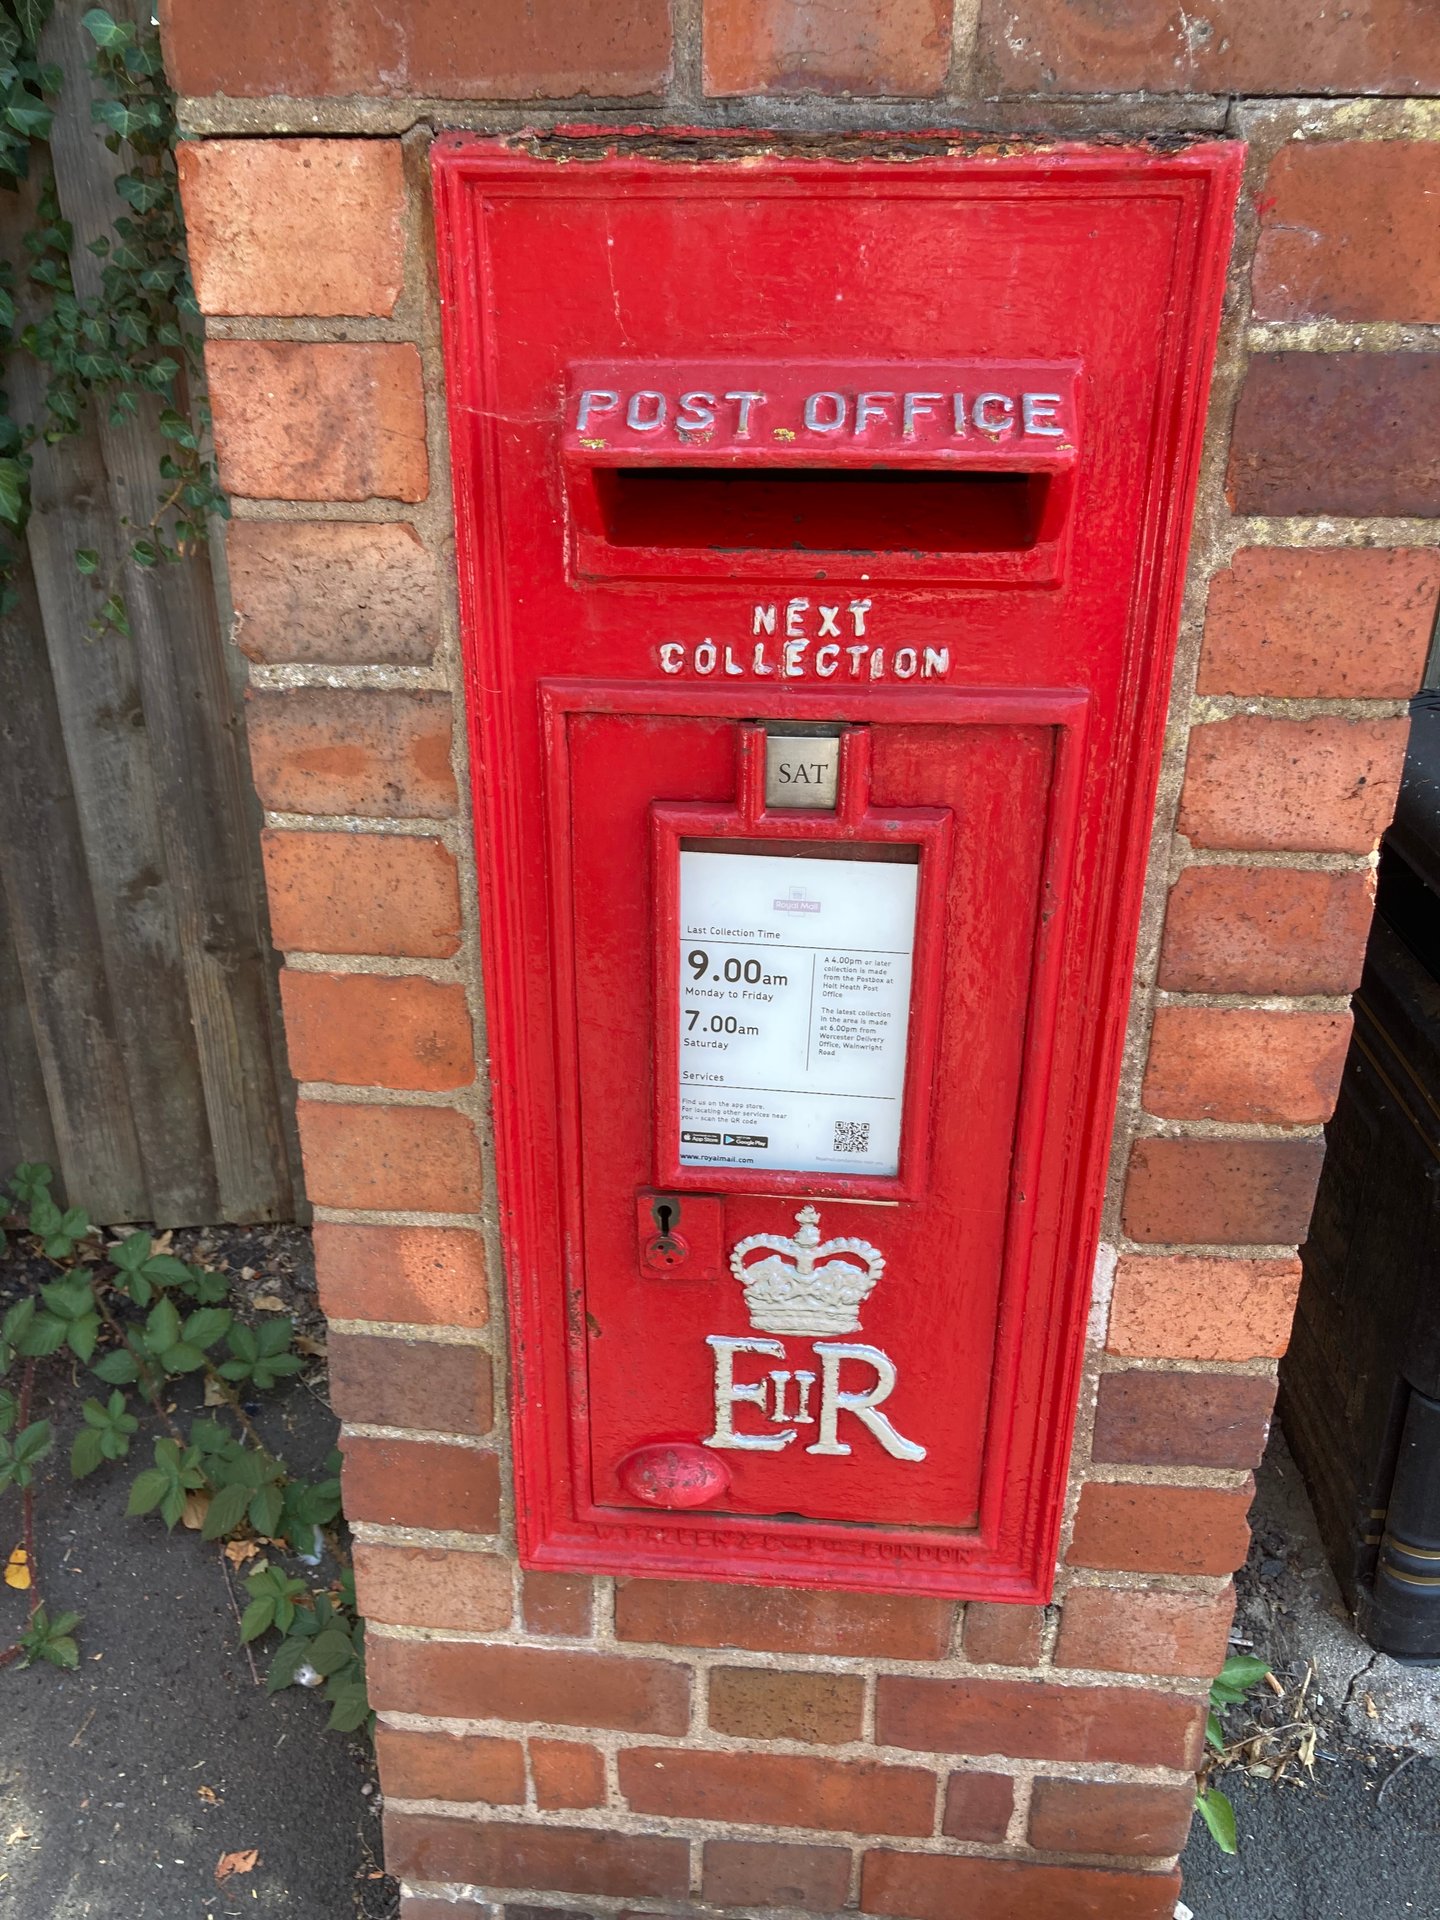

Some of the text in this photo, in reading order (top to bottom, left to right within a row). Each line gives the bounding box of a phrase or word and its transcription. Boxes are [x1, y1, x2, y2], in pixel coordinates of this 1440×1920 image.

[576, 389, 1065, 441] POST OFFICE
[753, 597, 873, 637] NEXT
[659, 638, 952, 680] COLLECTION
[778, 763, 829, 784] SAT
[687, 926, 781, 939] Last Collection Time
[831, 956, 862, 965] 4.00pm
[874, 959, 892, 967] later
[687, 949, 788, 986] 9.00am
[823, 966, 858, 974] collection
[856, 975, 884, 983] Postbox
[863, 984, 879, 992] Post
[685, 987, 774, 1003] Monday to Friday
[822, 990, 843, 998] Office
[836, 1008, 857, 1016] latest
[858, 1010, 892, 1018] collection
[684, 1009, 759, 1036] 7.00am
[829, 1025, 857, 1033] 6.00pm
[819, 1032, 885, 1043] Worcester Delivery
[683, 1037, 729, 1051] Saturday
[843, 1042, 883, 1052] Wainwright
[682, 1070, 725, 1082] Services
[694, 1107, 721, 1115] locating
[722, 1108, 741, 1116] other
[742, 1110, 770, 1118] services
[680, 1153, 754, 1164] www.royalmail.com
